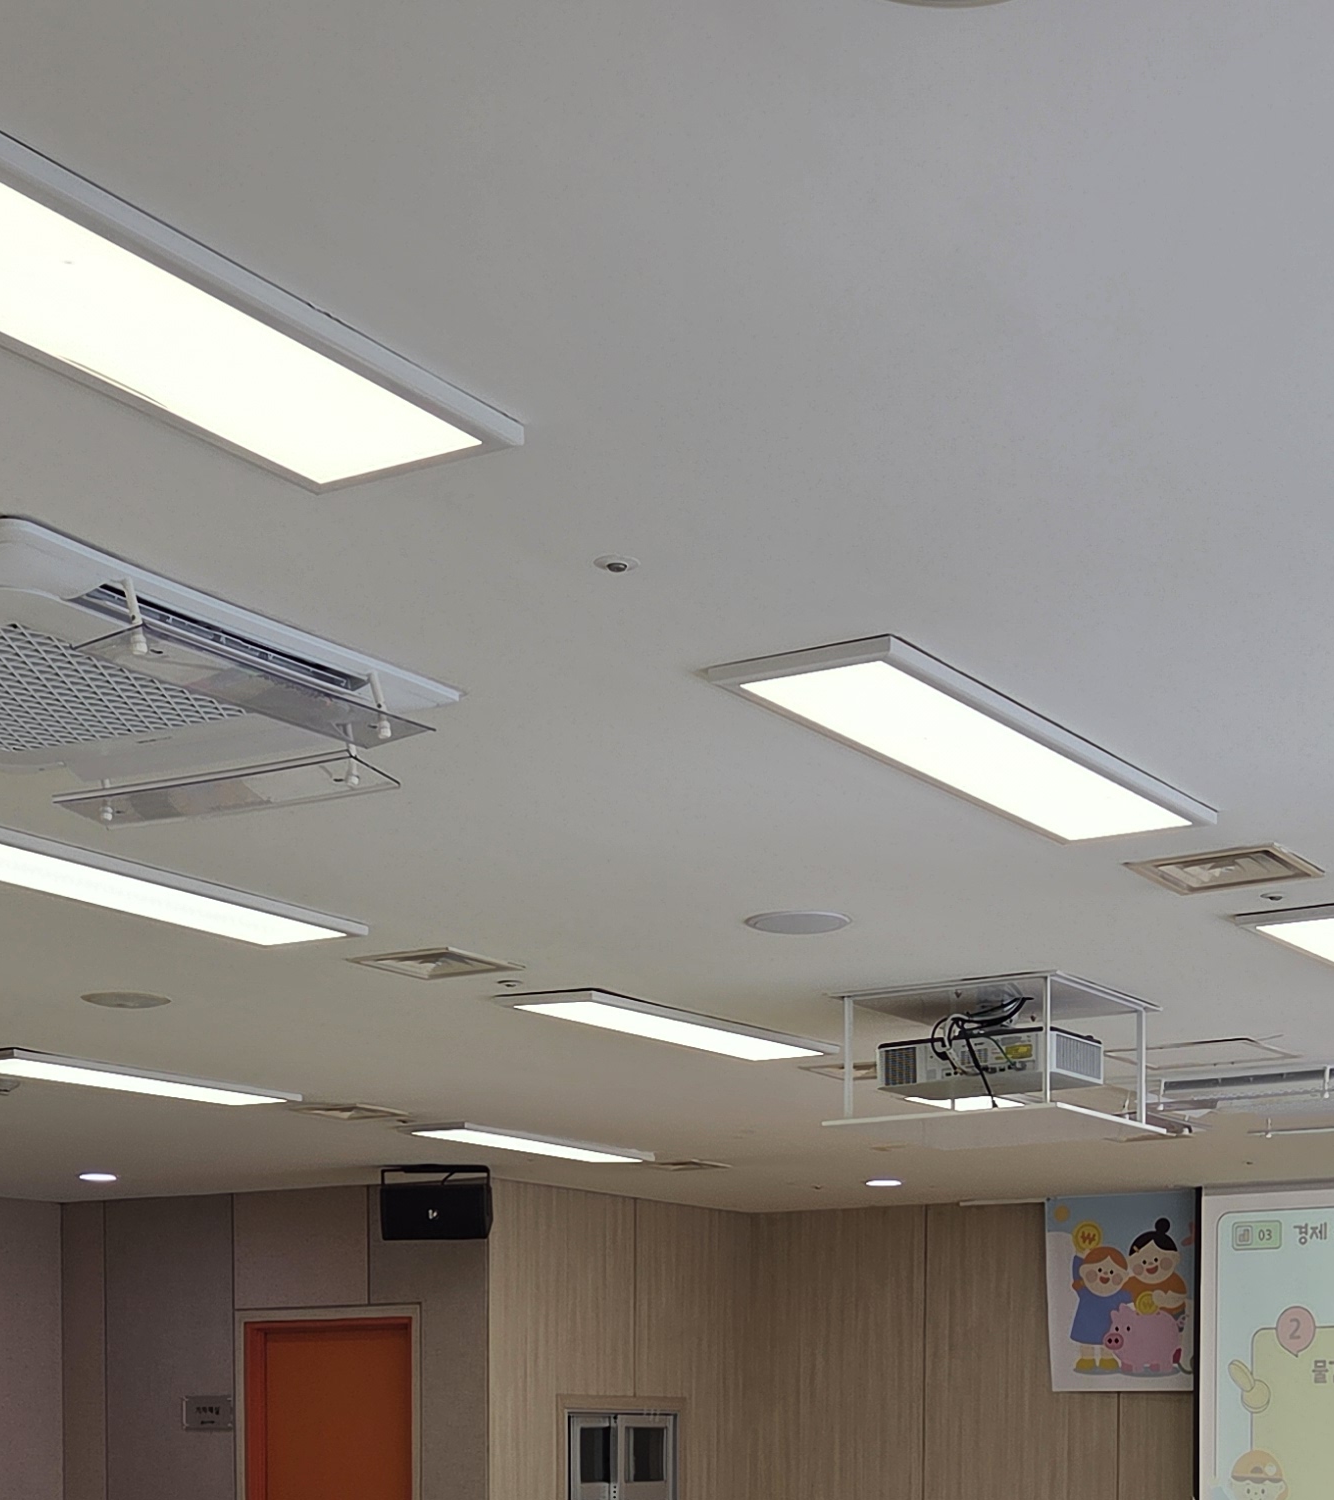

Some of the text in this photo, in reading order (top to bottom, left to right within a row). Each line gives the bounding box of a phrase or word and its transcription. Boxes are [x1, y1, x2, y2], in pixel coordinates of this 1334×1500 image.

[1258, 1229, 1273, 1241] 03
[1293, 1222, 1327, 1245] 경제
[1289, 1318, 1301, 1340] 2
